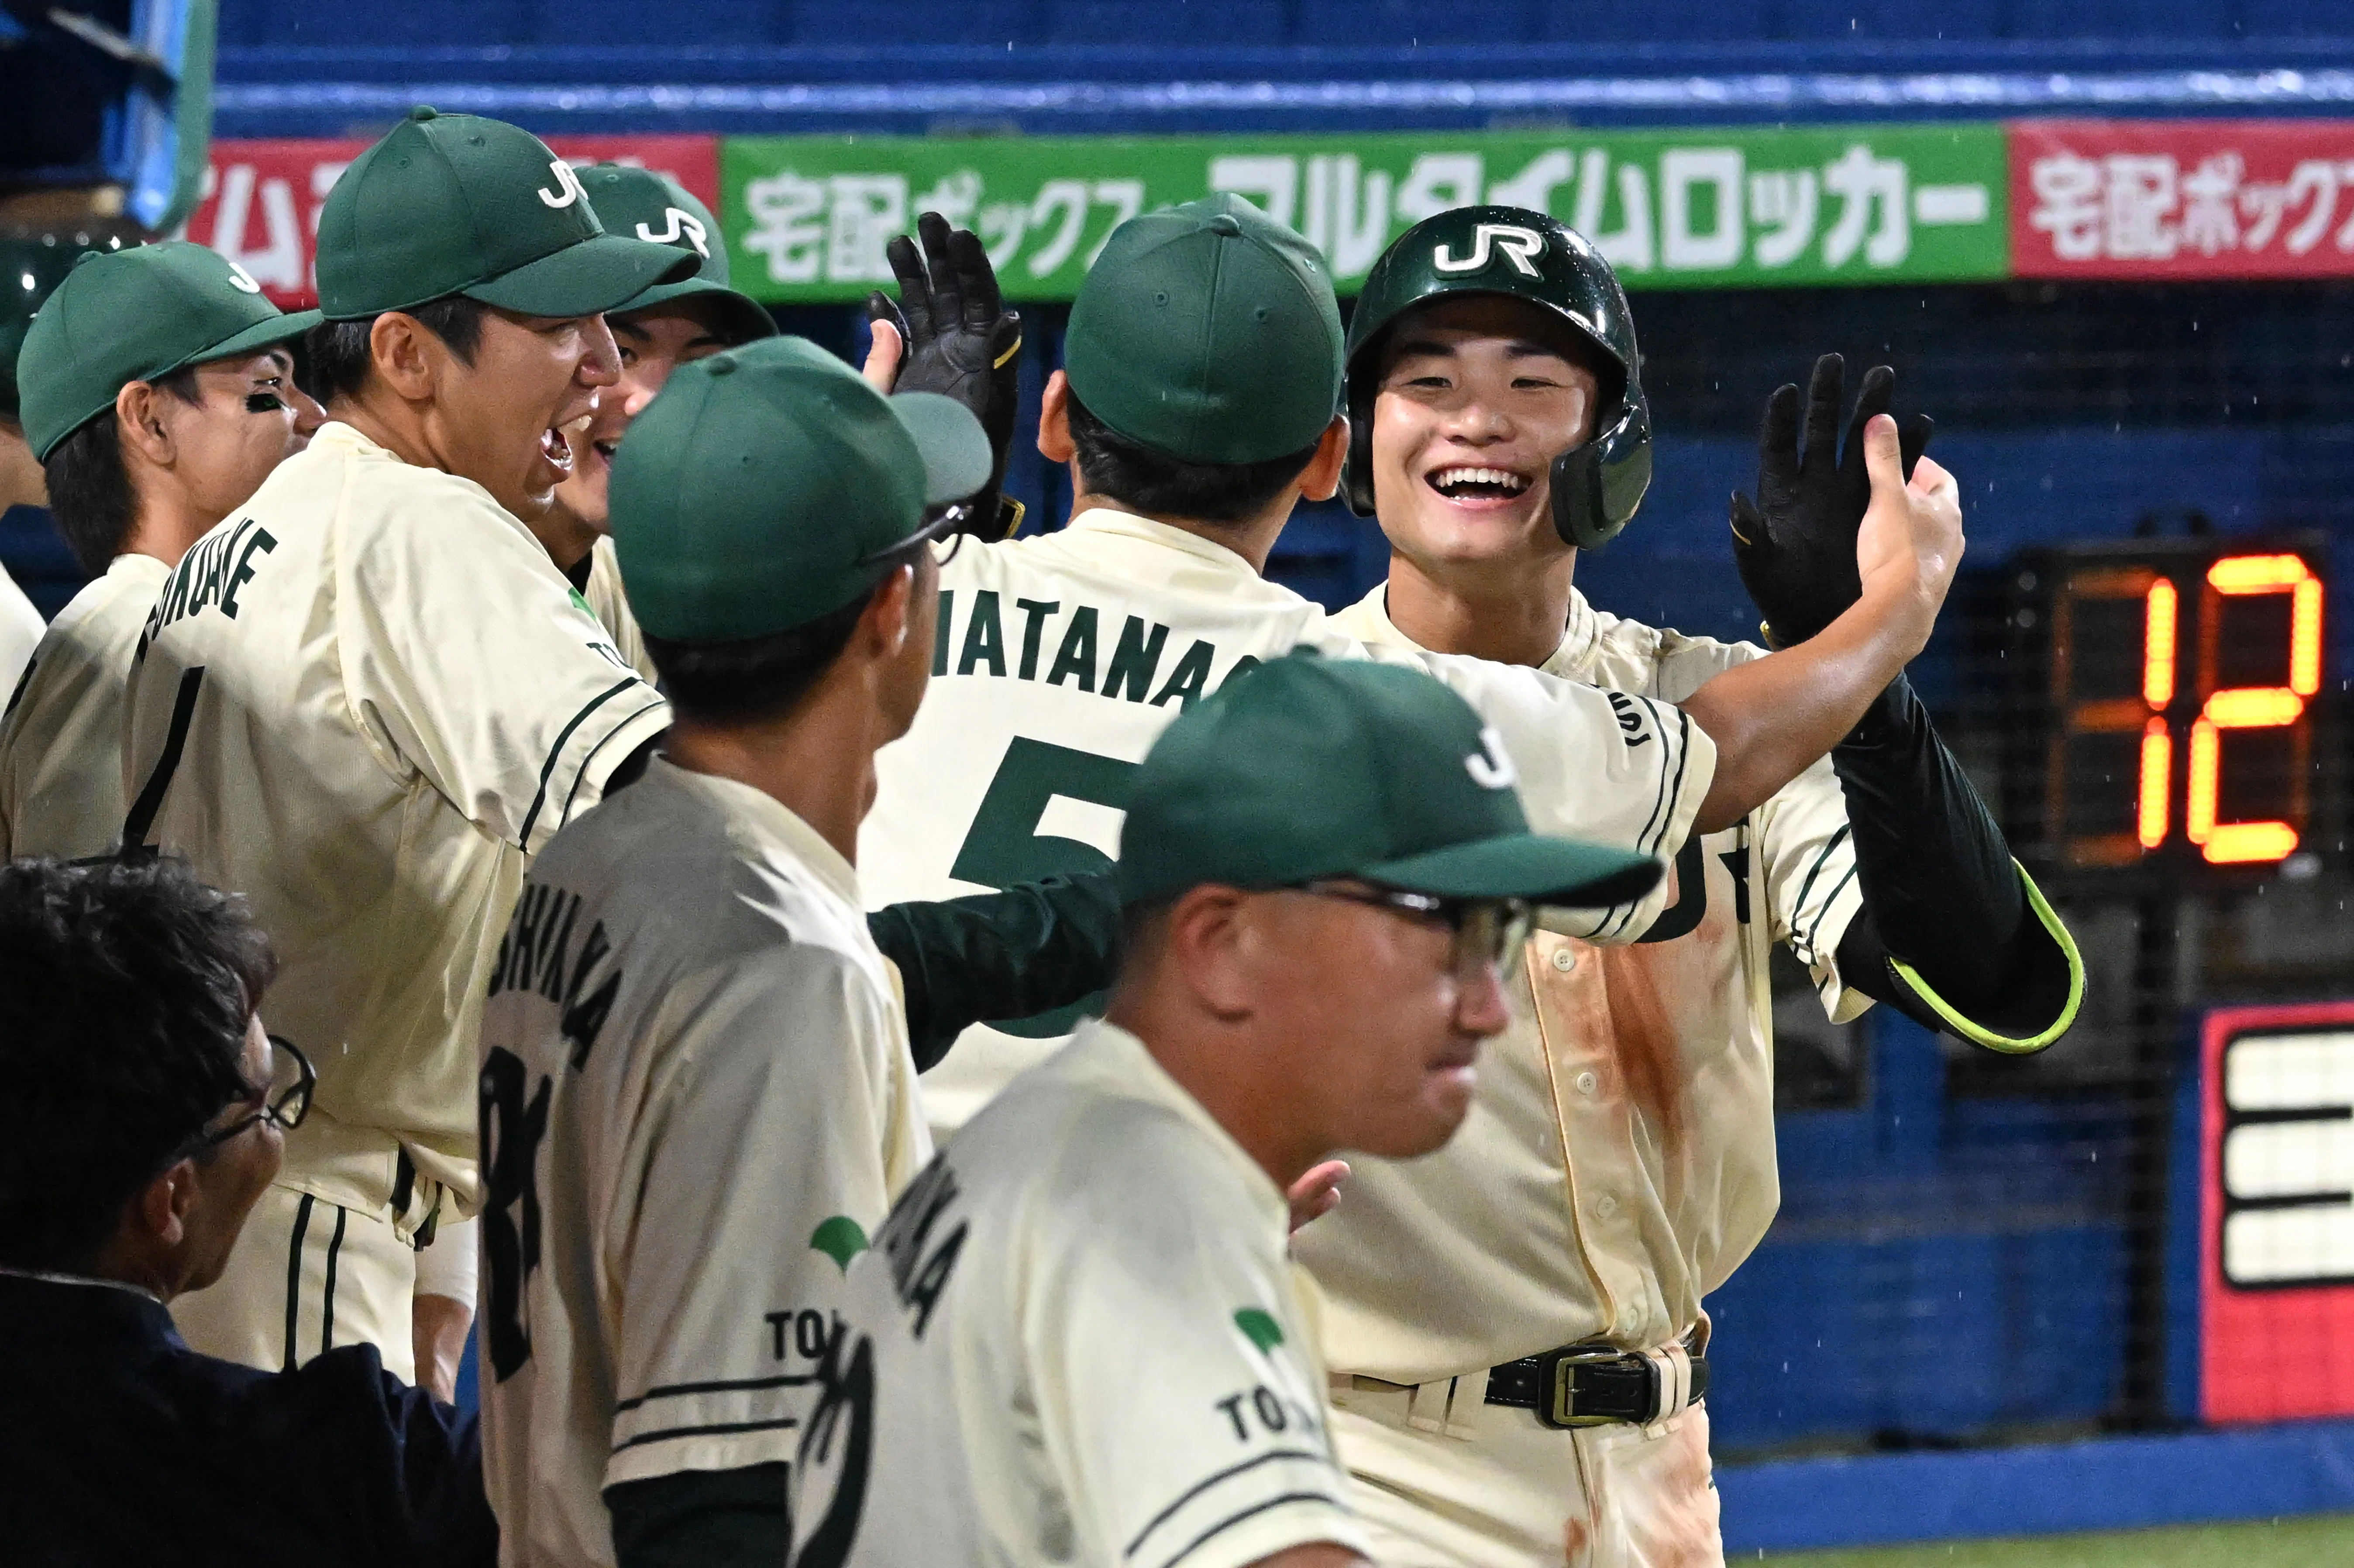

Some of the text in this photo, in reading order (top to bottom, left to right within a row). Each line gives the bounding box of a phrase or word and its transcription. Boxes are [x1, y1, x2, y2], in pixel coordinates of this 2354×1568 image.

[636, 208, 710, 259] JR
[1434, 225, 1542, 277] JR
[229, 262, 260, 293] J
[931, 589, 1262, 716] ATANA
[2138, 554, 2323, 863] 12
[1464, 728, 1516, 789] J
[764, 1309, 826, 1361] TO
